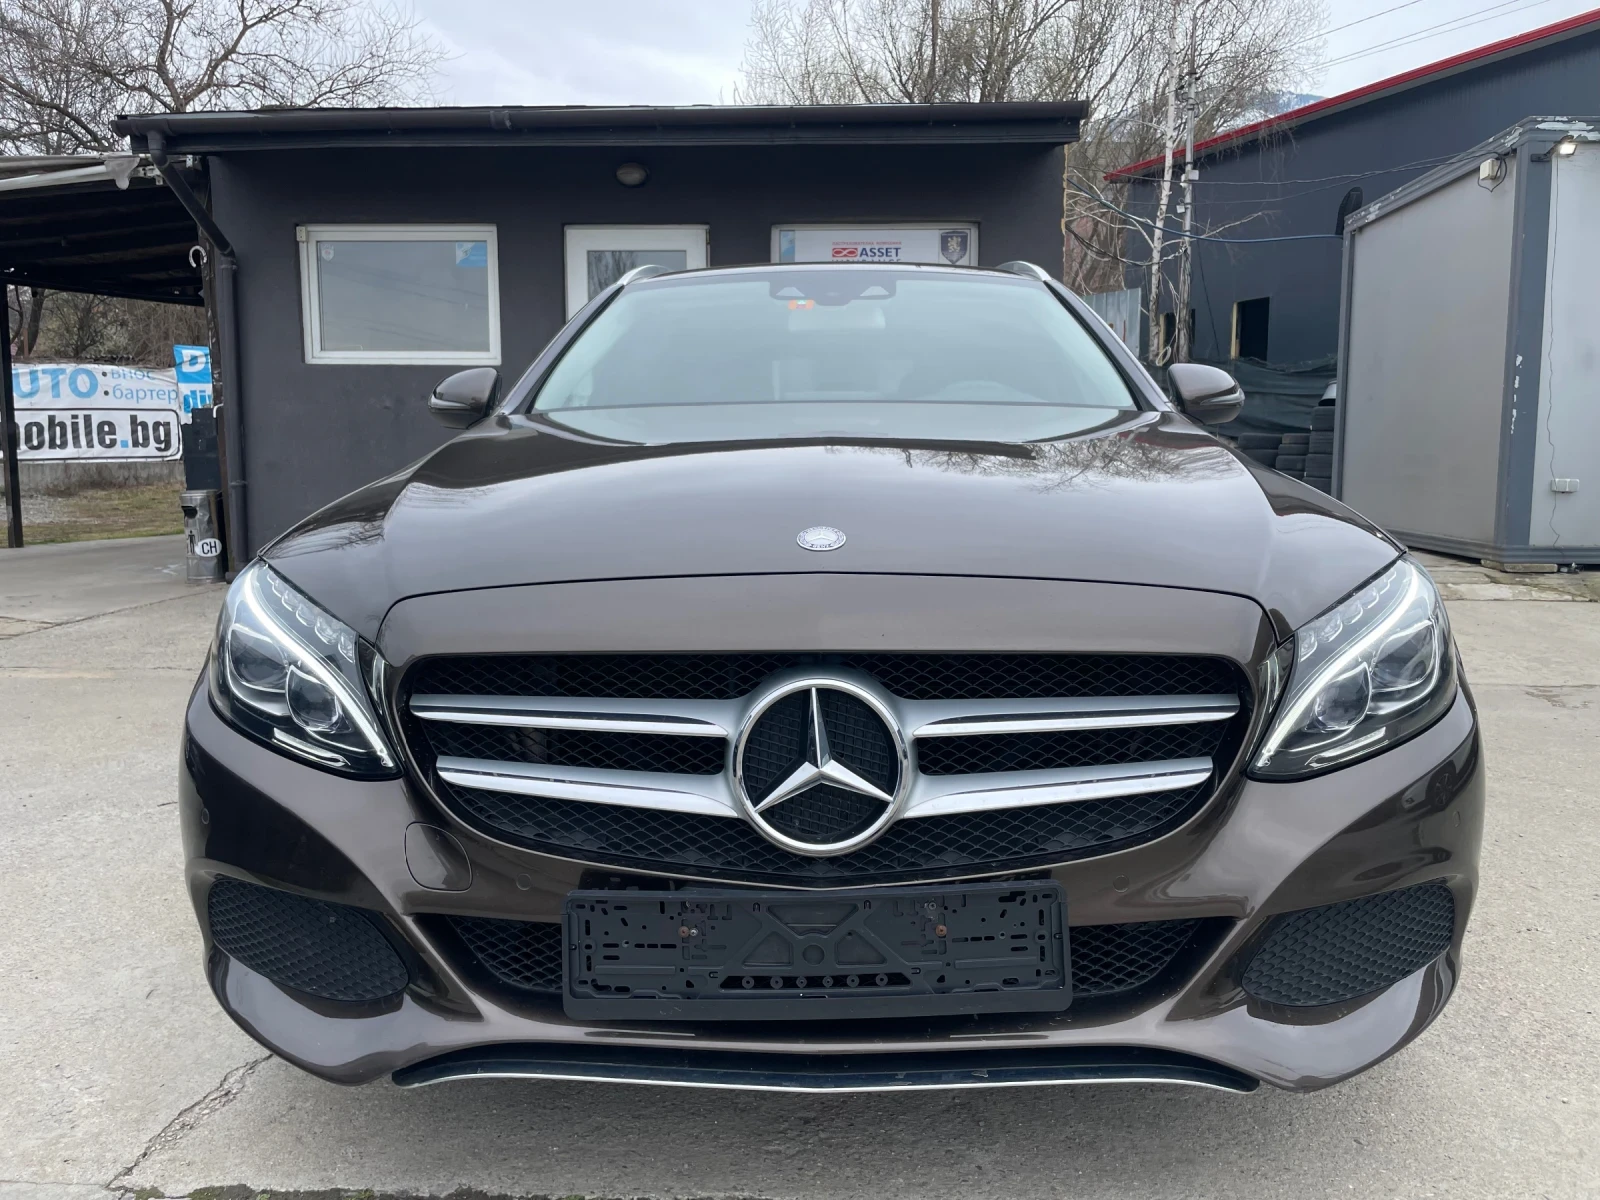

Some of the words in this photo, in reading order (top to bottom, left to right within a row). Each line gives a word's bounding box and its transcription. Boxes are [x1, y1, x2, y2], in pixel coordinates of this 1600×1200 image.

[859, 247, 902, 258] ASSET
[112, 383, 179, 405] бартер
[0, 413, 172, 452] obile.bg
[201, 540, 218, 555] CH
